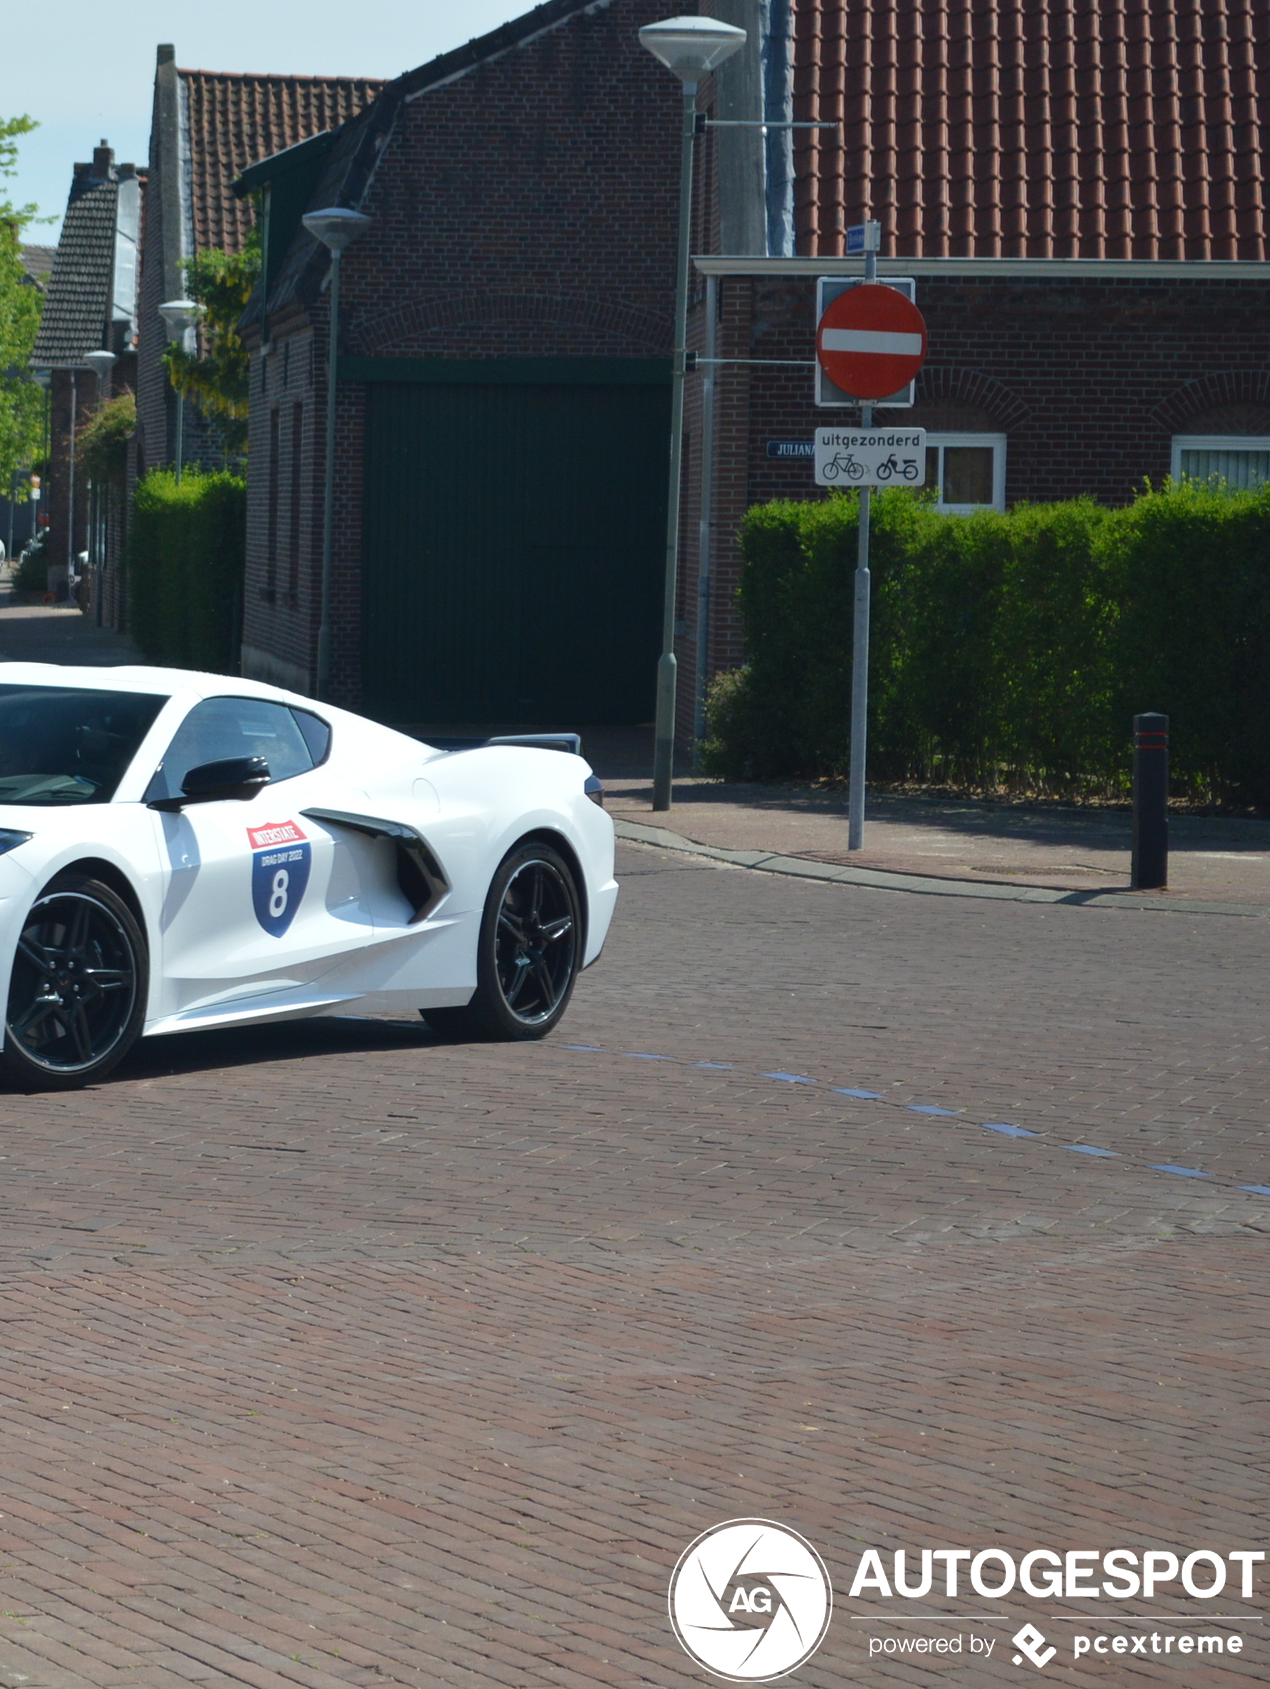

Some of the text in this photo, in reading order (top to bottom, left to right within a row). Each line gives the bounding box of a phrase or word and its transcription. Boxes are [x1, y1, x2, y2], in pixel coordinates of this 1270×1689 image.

[822, 434, 920, 449] uitgezonderd
[251, 825, 300, 846] INTERSTATE
[261, 849, 303, 867] DRAG DAY 2022
[269, 869, 289, 918] 8
